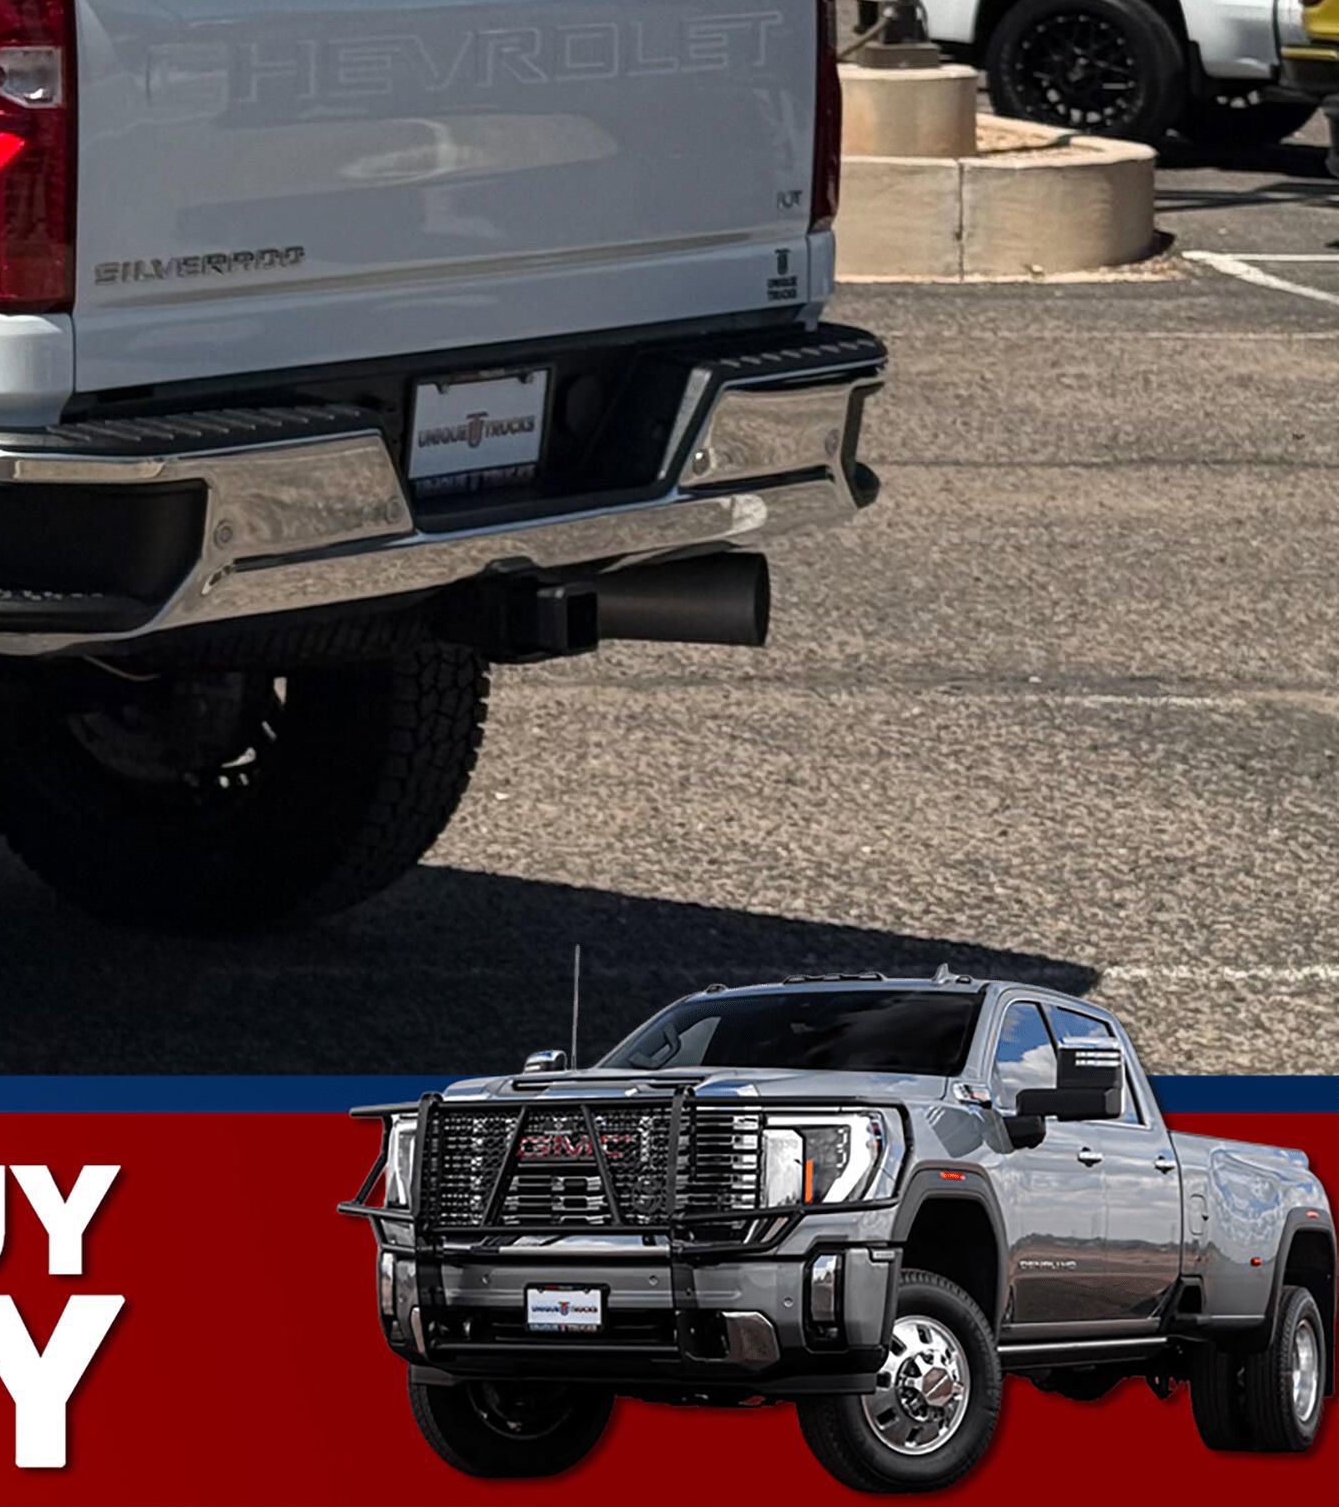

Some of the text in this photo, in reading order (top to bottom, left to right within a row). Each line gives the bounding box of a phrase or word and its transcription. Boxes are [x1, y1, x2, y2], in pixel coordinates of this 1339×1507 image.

[146, 9, 784, 108] CHEVROLET
[94, 245, 306, 286] SILVERADO
[418, 415, 536, 448] UNIQUE TRUCKS
